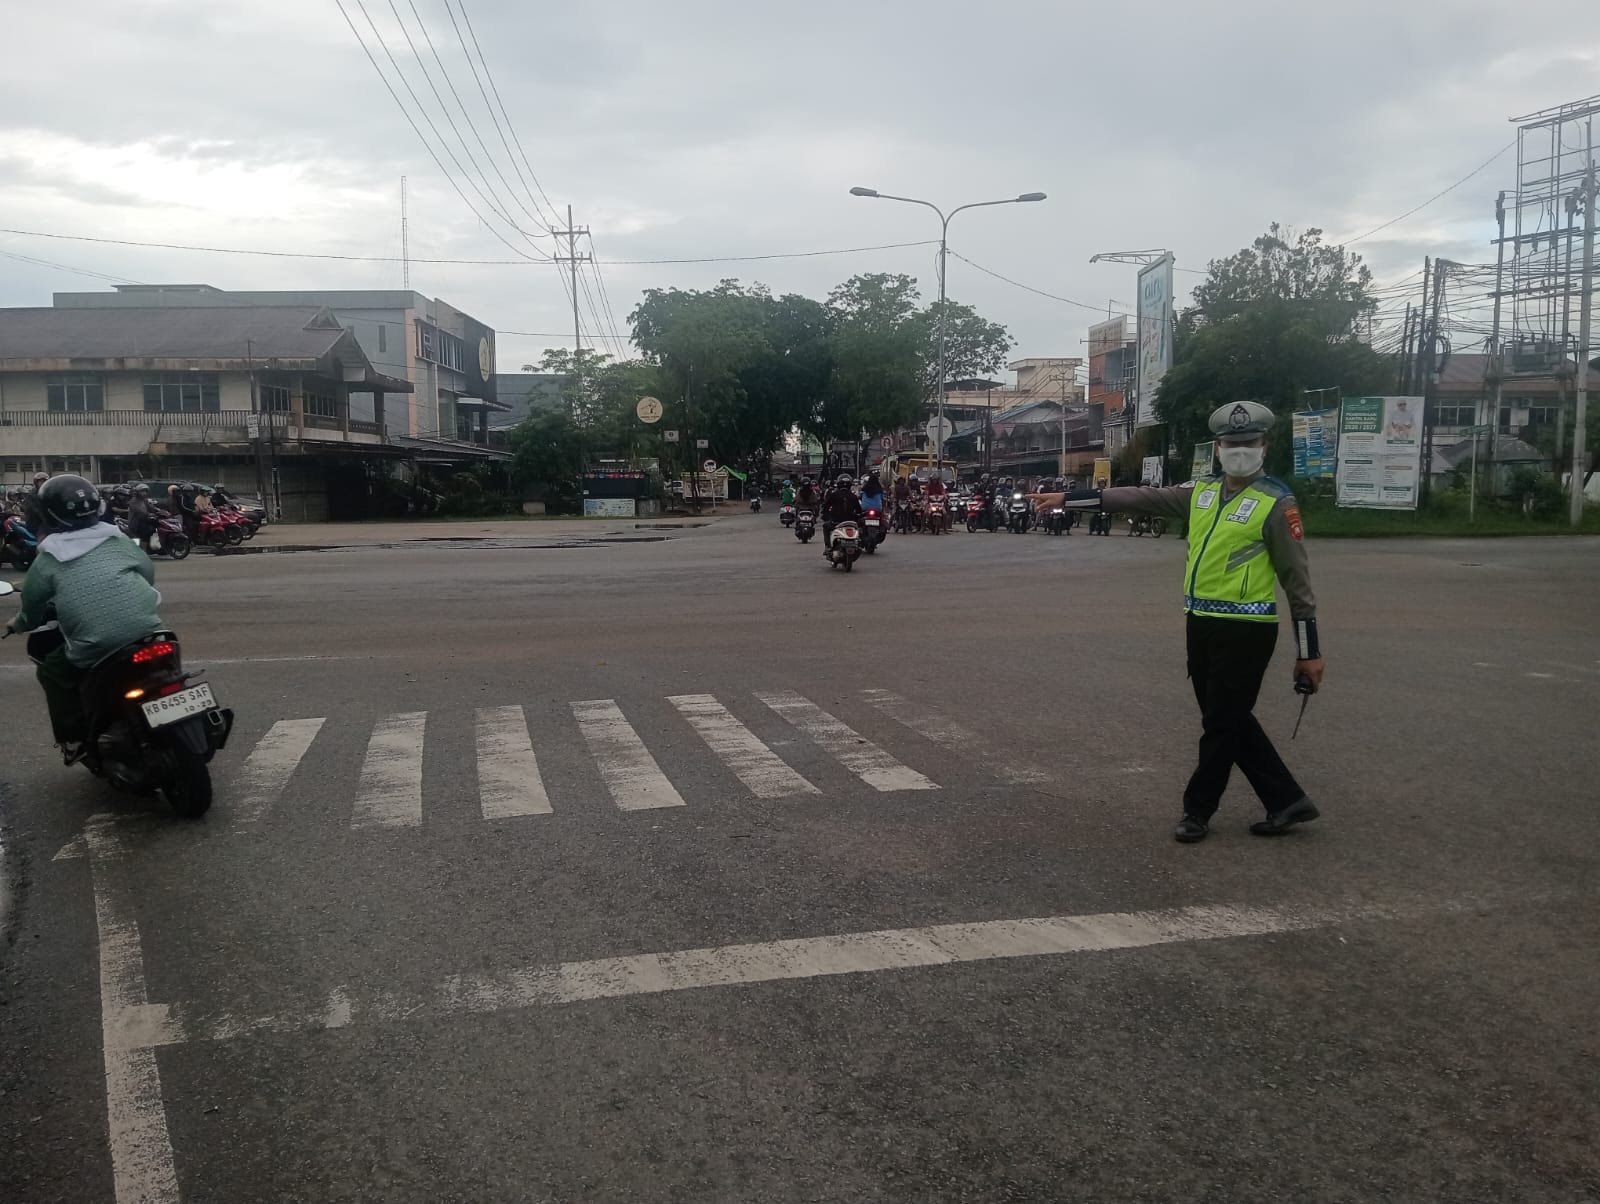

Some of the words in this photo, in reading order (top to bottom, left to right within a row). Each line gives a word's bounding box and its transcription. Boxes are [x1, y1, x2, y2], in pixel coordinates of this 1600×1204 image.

[1227, 514, 1248, 524] POLISI
[145, 703, 160, 716] KB
[160, 695, 187, 710] 6455
[189, 687, 208, 701] SAF
